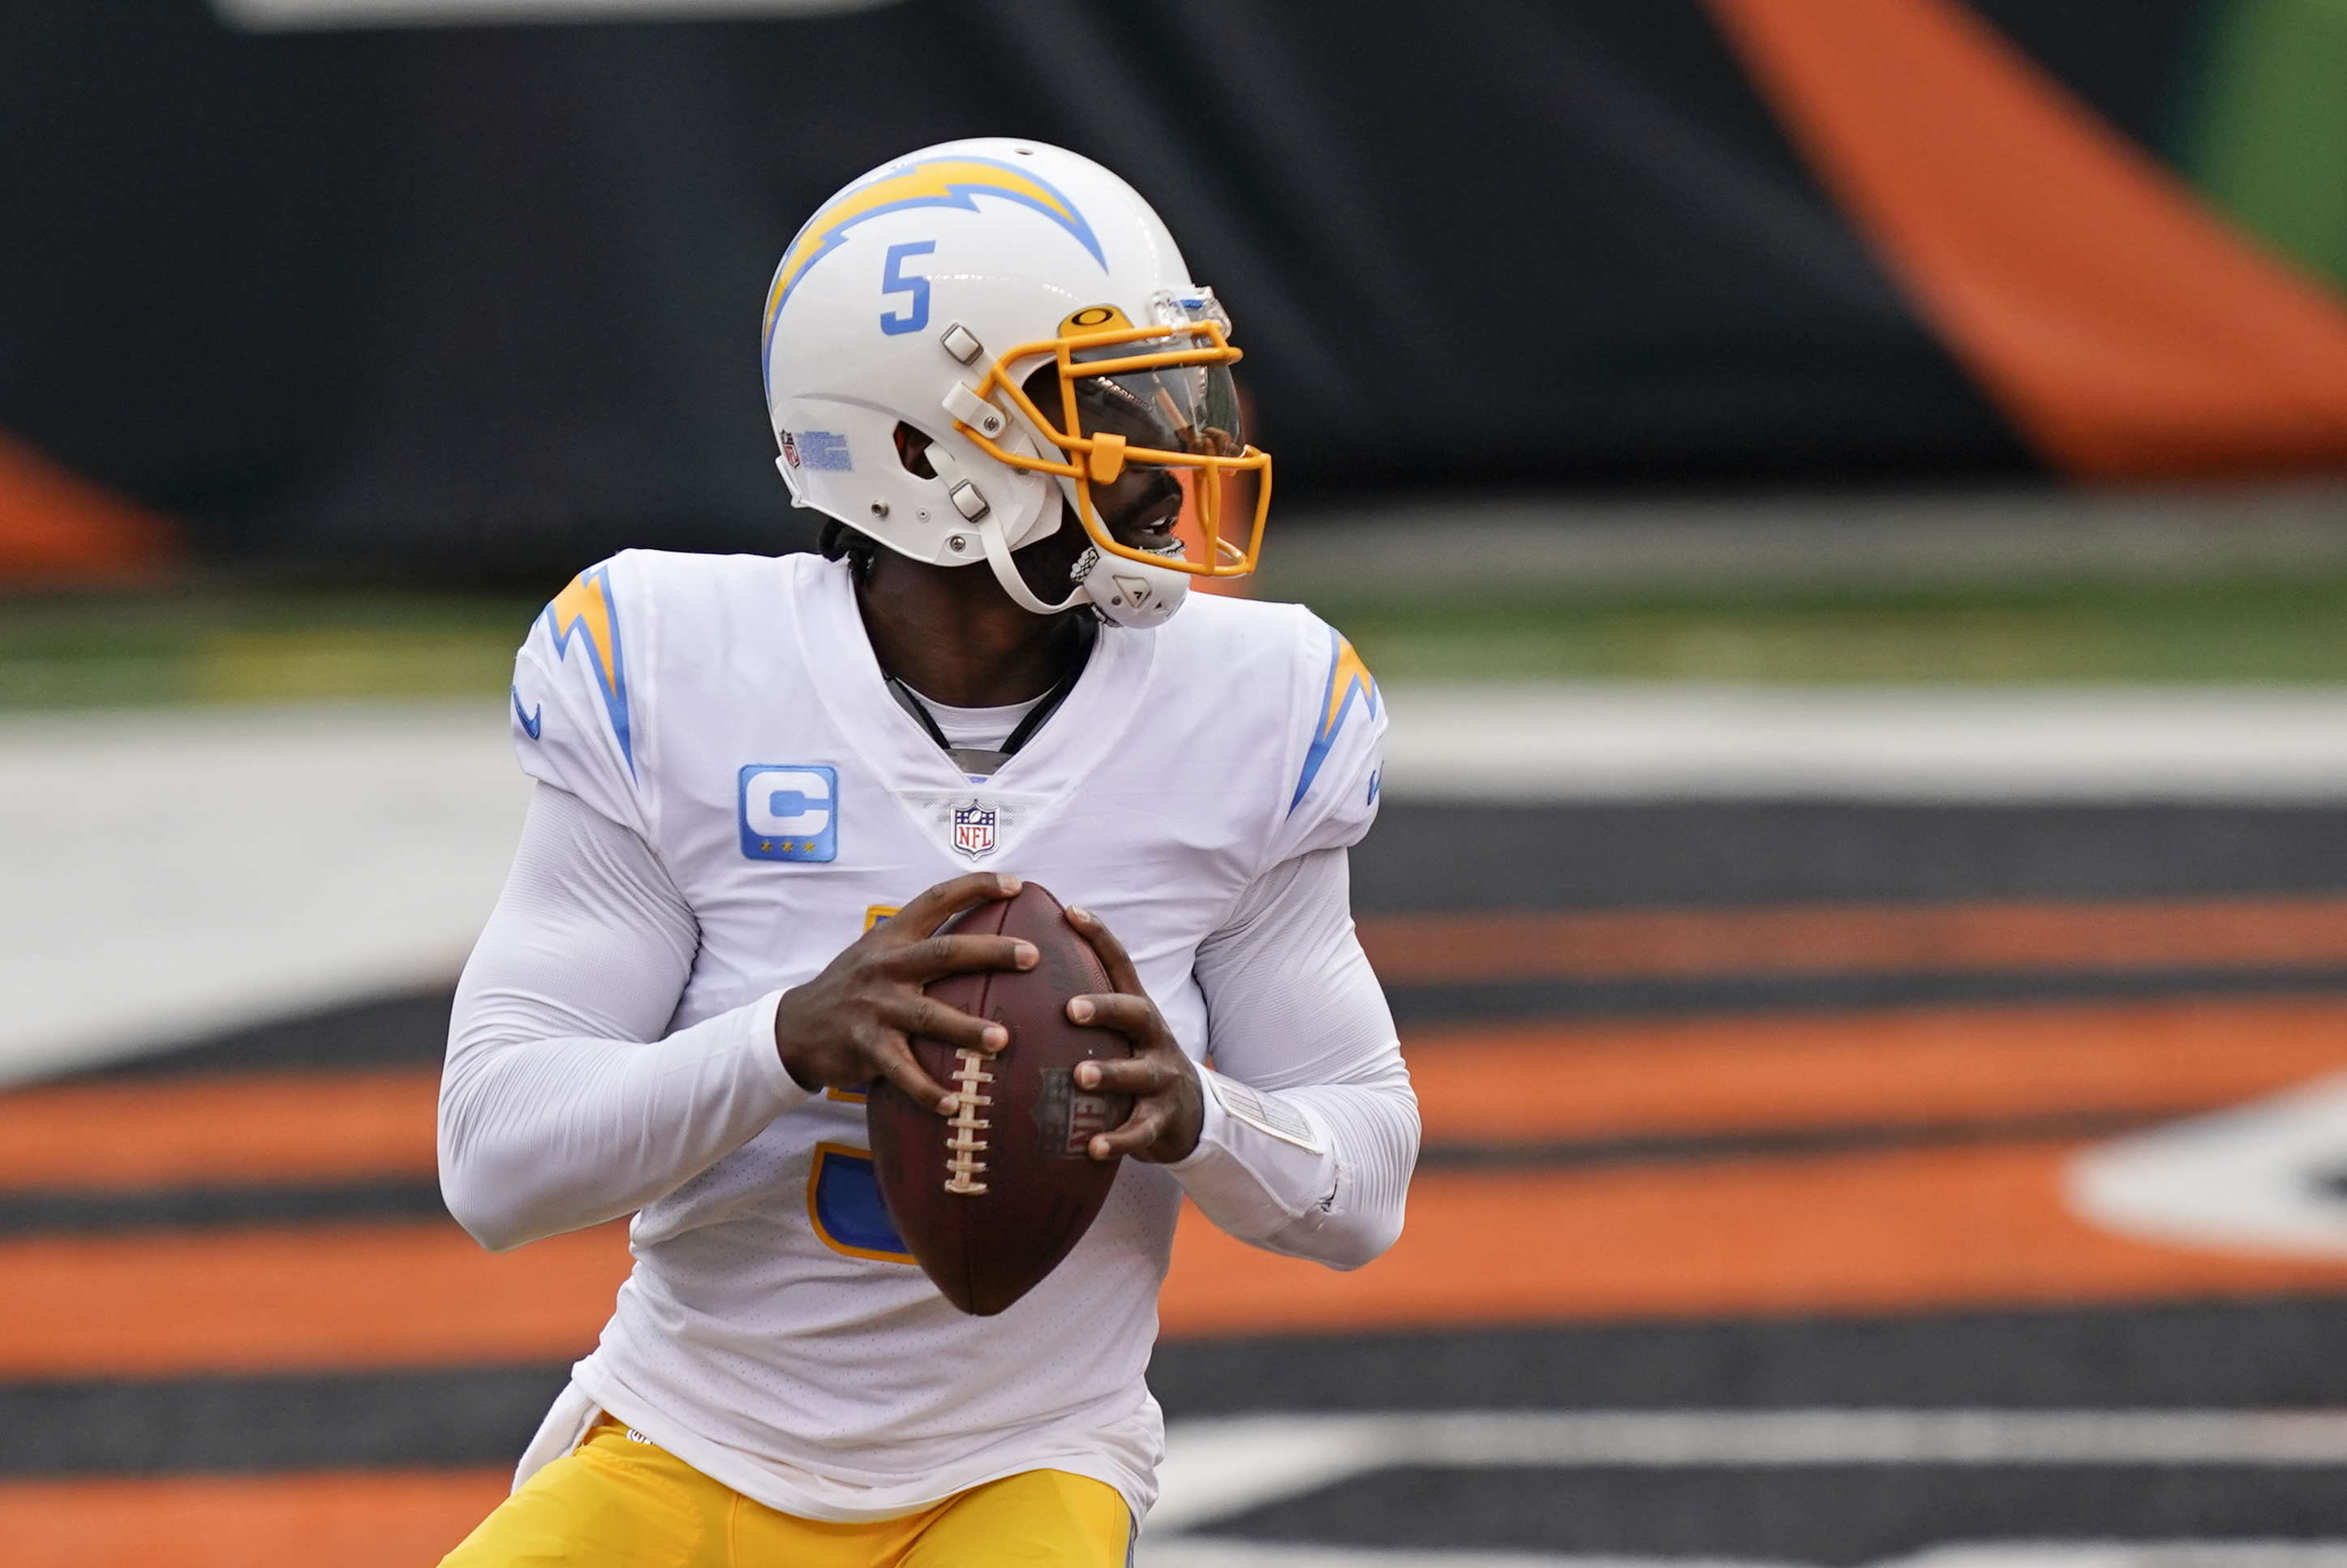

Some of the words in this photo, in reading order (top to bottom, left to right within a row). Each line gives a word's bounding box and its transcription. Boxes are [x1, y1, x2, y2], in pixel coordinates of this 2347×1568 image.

[880, 240, 936, 336] 5
[746, 771, 829, 836] C
[959, 827, 991, 848] NFL
[1068, 1092, 1106, 1149] NF
